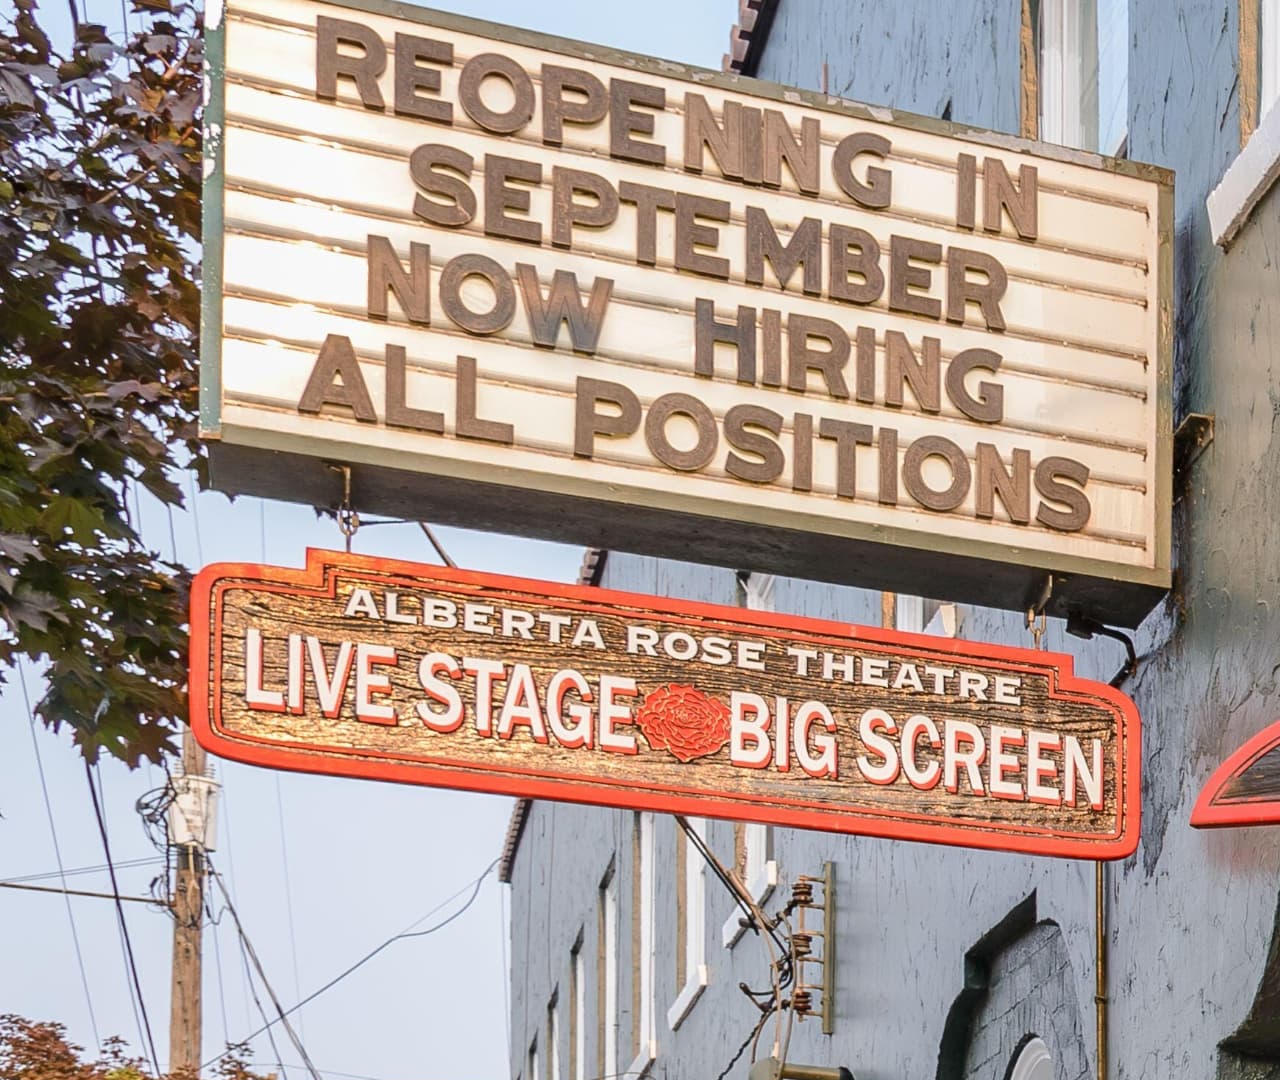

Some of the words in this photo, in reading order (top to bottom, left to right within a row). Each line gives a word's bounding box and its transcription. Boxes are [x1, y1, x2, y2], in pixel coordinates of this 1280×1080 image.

[315, 16, 893, 209] REOPENING
[956, 151, 1038, 241] IN
[366, 234, 614, 355] NOW
[694, 298, 1004, 423] HIRING
[409, 143, 1008, 333] SEPTEMBER
[298, 333, 513, 444] ALL
[575, 376, 1091, 532] POSITIONS
[244, 628, 398, 725] LIVE
[417, 651, 639, 755] STAGE
[730, 691, 838, 778] BIG
[856, 707, 1103, 810] SCREEN
[344, 586, 604, 651] ALBERTA
[626, 626, 766, 671] ROSE
[788, 647, 1021, 704] THEATRE
